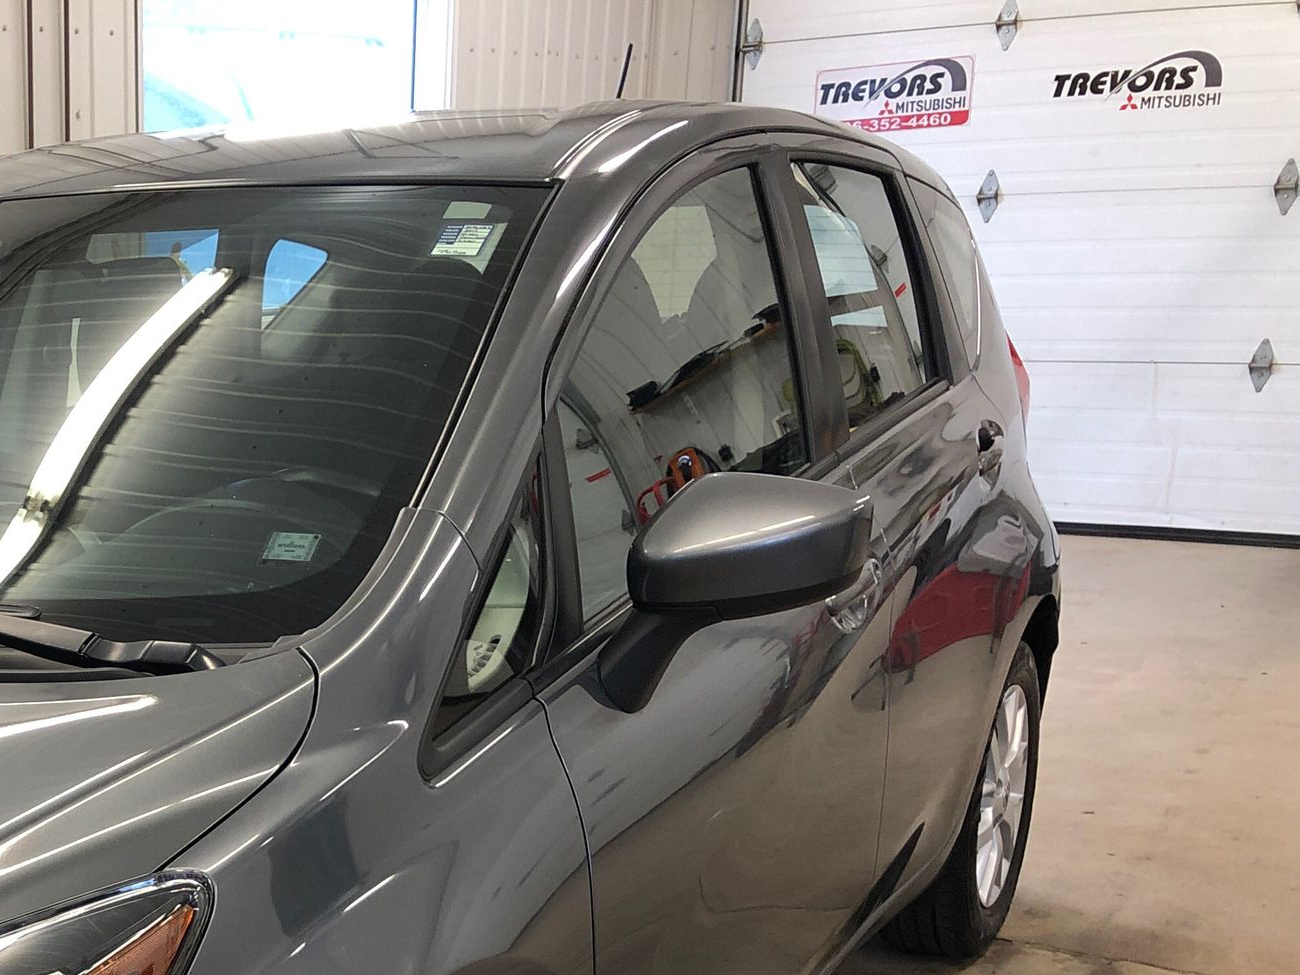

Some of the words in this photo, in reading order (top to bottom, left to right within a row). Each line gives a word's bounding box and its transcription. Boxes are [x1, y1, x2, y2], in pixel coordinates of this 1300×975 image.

[819, 71, 946, 105] TREVORS
[1052, 65, 1199, 98] TREVORS
[895, 96, 966, 114] MITSUBISHI
[1140, 92, 1222, 110] MITSUBISHI
